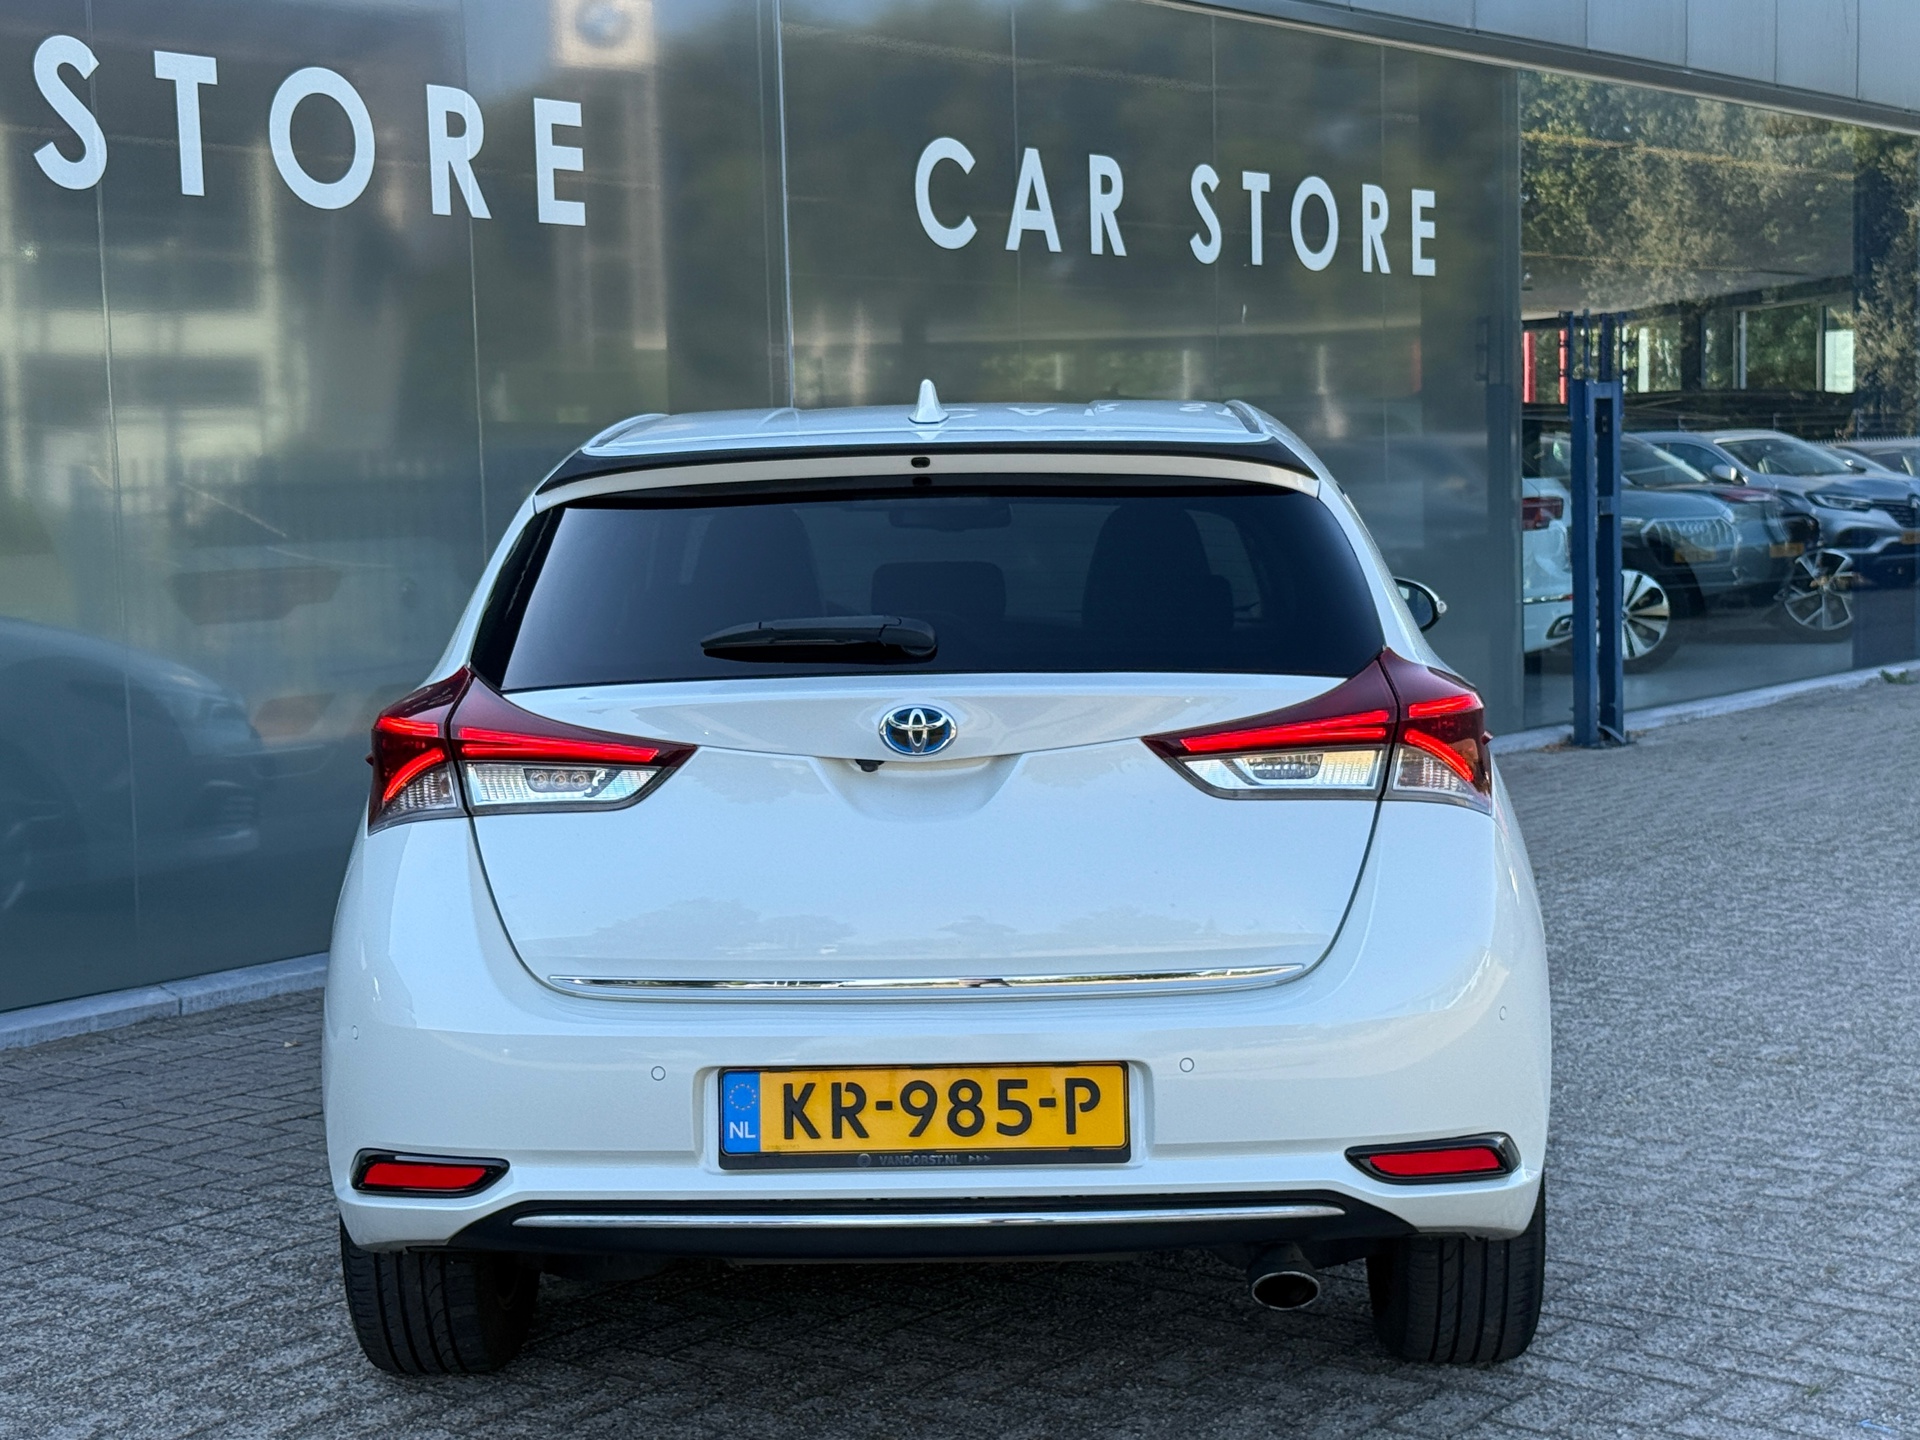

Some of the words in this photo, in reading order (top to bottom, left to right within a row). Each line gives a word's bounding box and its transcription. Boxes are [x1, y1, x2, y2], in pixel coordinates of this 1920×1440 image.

[33, 34, 587, 227] STORE
[914, 136, 1128, 257] CAR
[1189, 163, 1437, 278] STORE
[729, 1121, 756, 1139] NL
[783, 1077, 1101, 1140] KR-985-P
